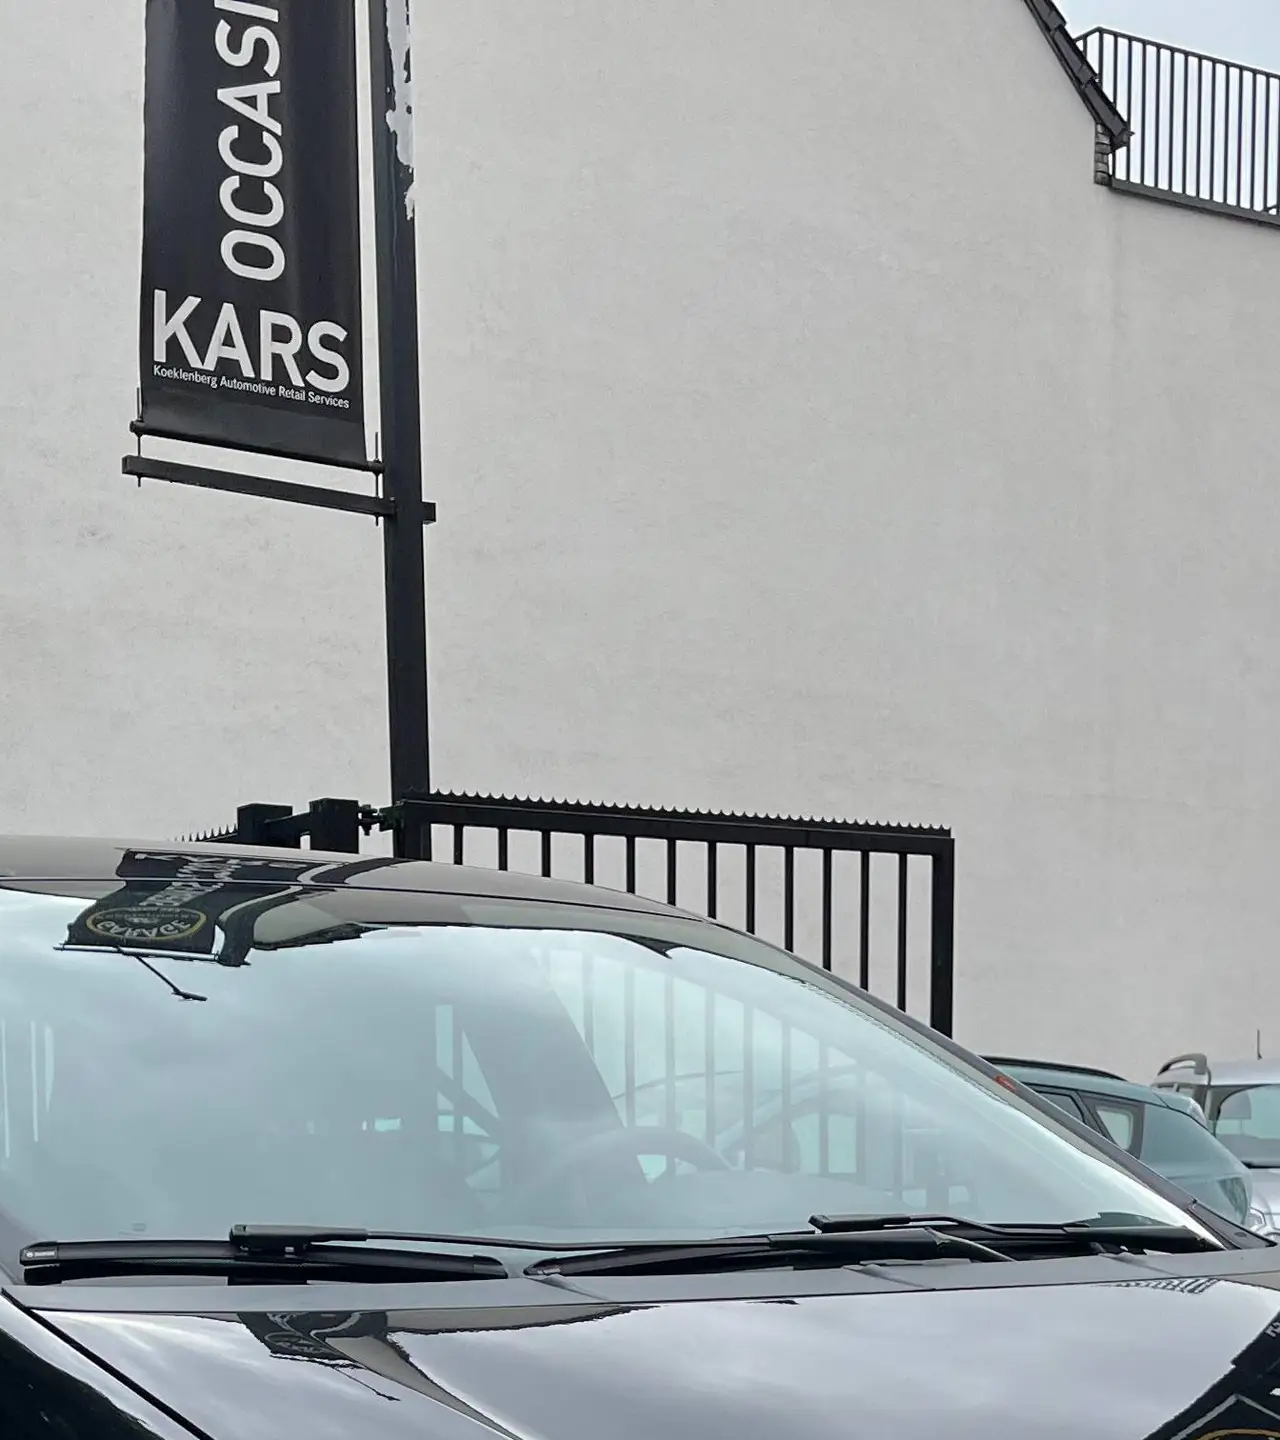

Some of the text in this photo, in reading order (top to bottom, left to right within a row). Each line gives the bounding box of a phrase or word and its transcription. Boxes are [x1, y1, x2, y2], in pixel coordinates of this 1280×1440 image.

[153, 289, 351, 394] KARS
[153, 364, 350, 409] Koeklenberg Automotive Retail Services
